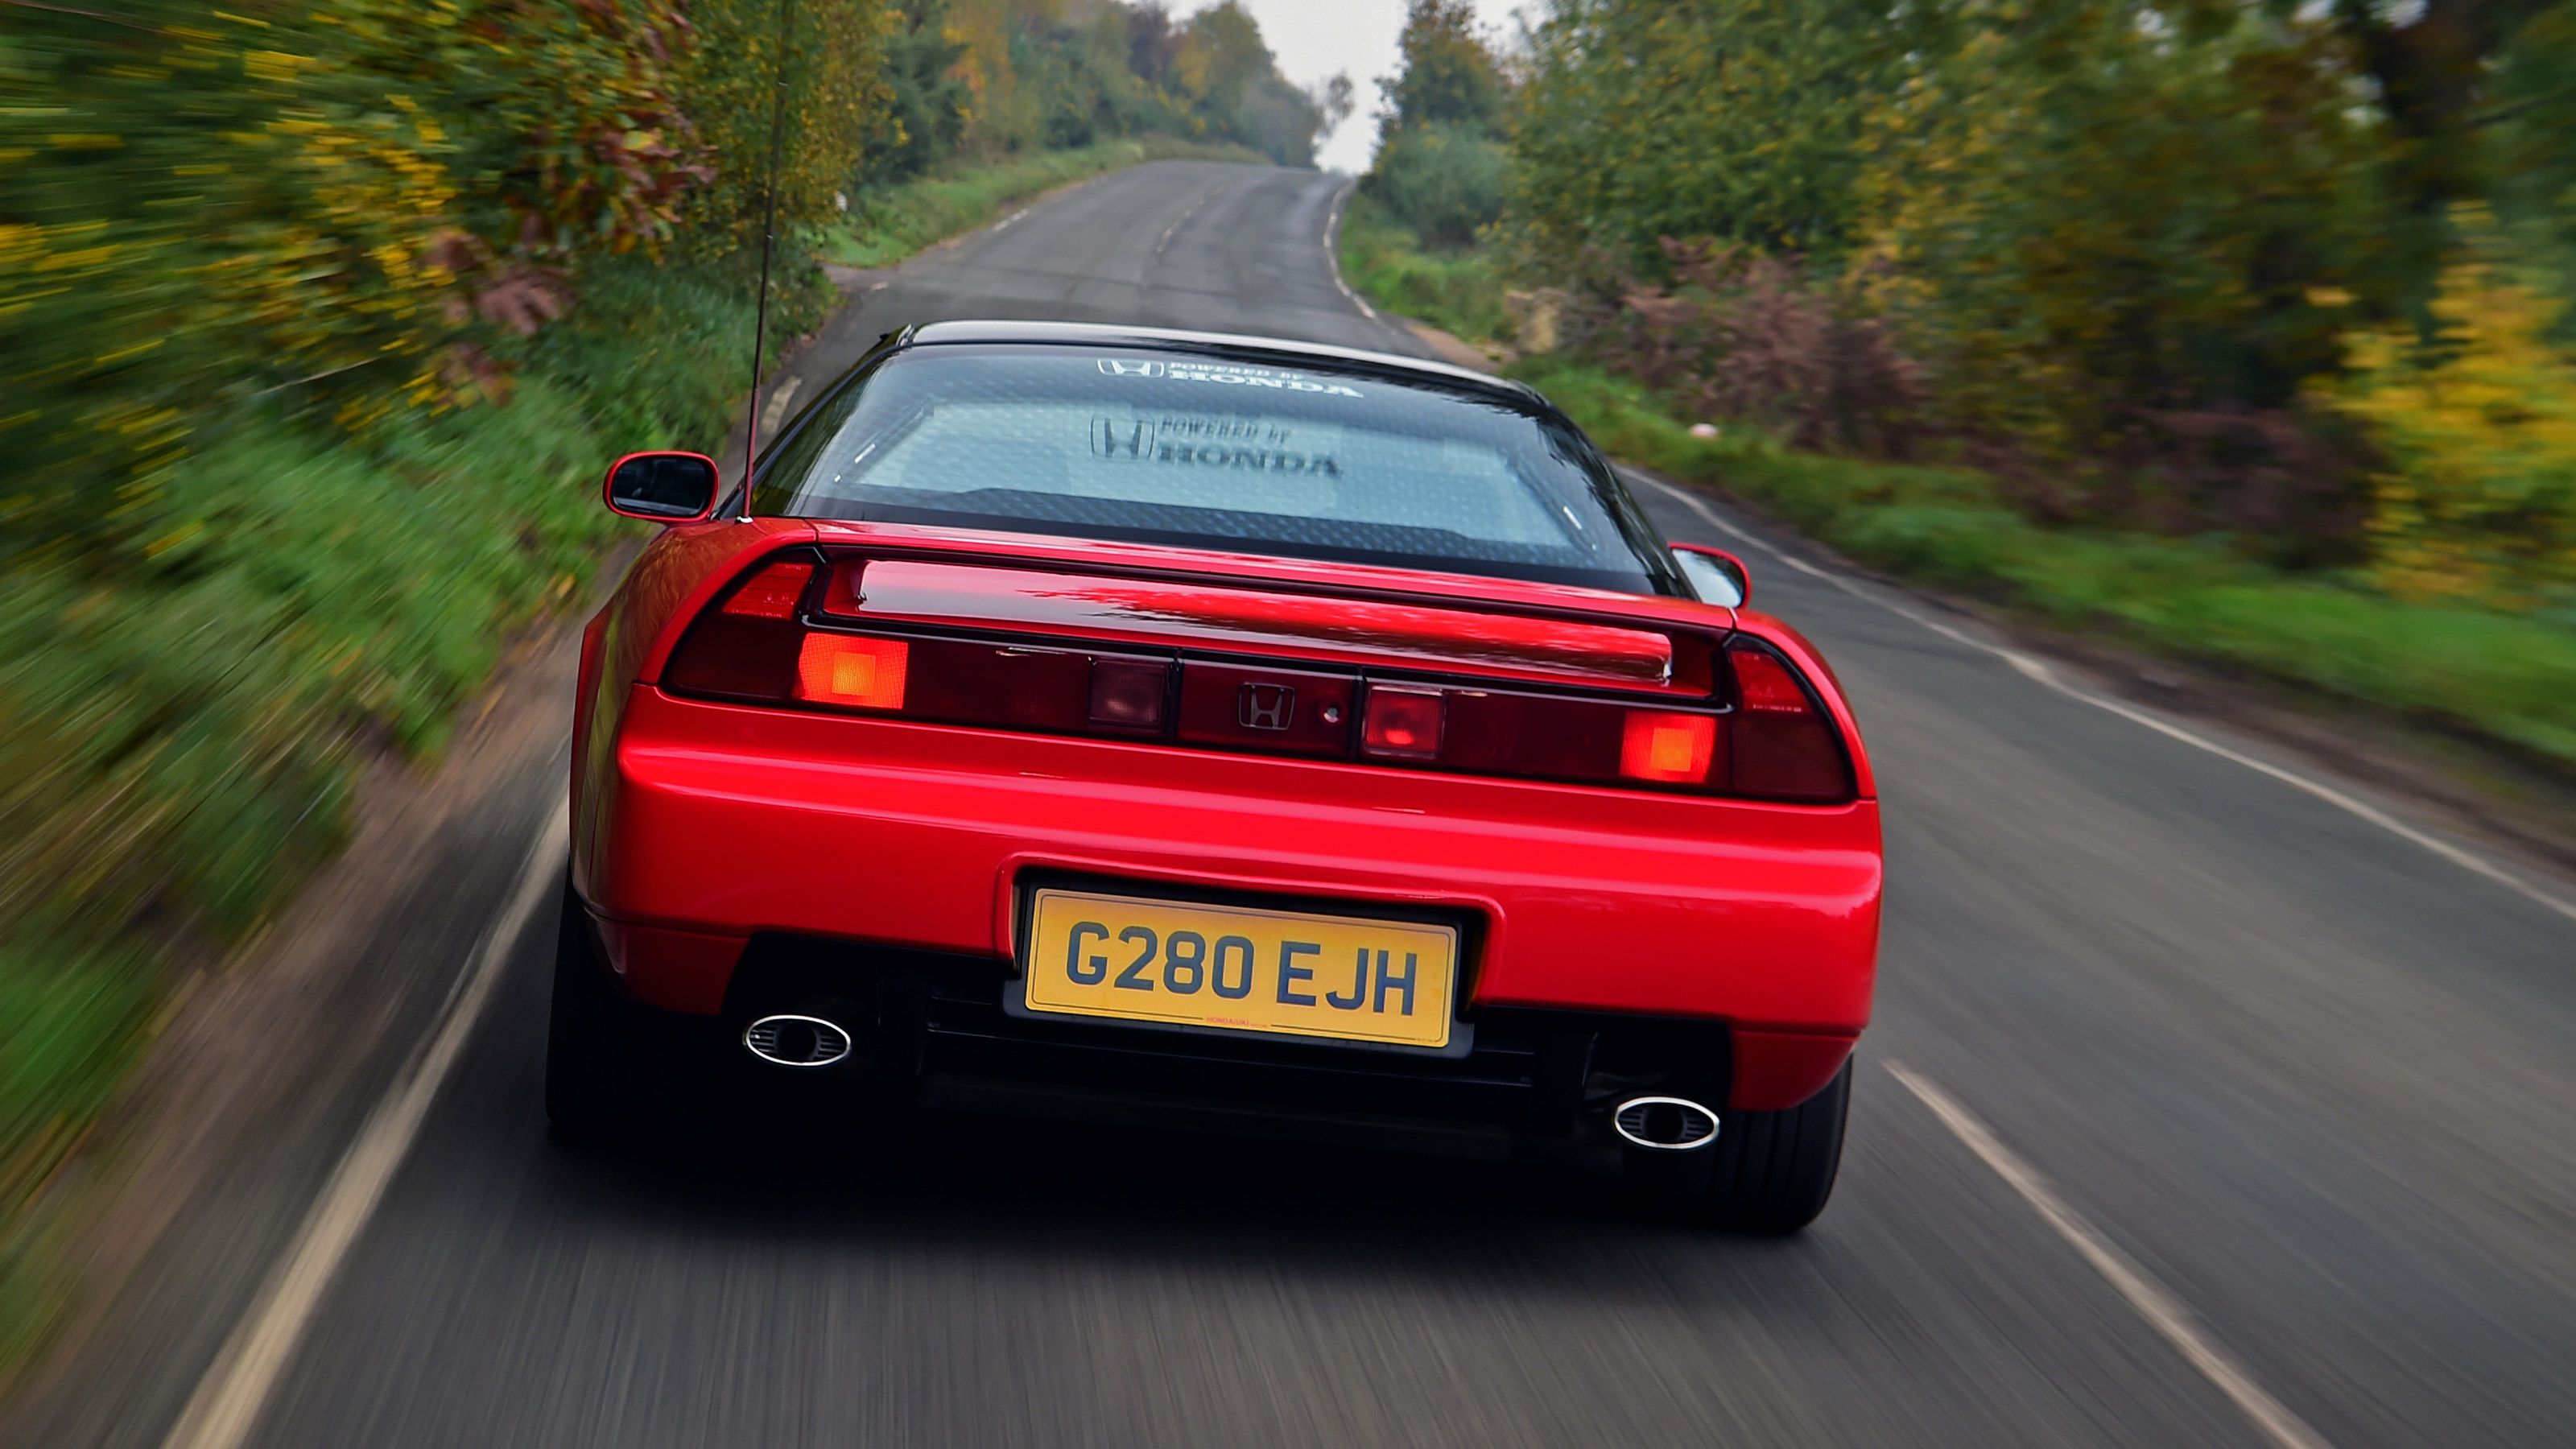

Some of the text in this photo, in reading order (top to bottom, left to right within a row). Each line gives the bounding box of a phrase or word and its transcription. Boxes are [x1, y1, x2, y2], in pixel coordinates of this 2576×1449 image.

[1169, 369, 1364, 398] HONDA
[1170, 362, 1270, 378] POWERED
[1162, 417, 1261, 440] POWERED
[1159, 444, 1341, 477] HONDA
[1066, 920, 1419, 1017] G280 EJH
